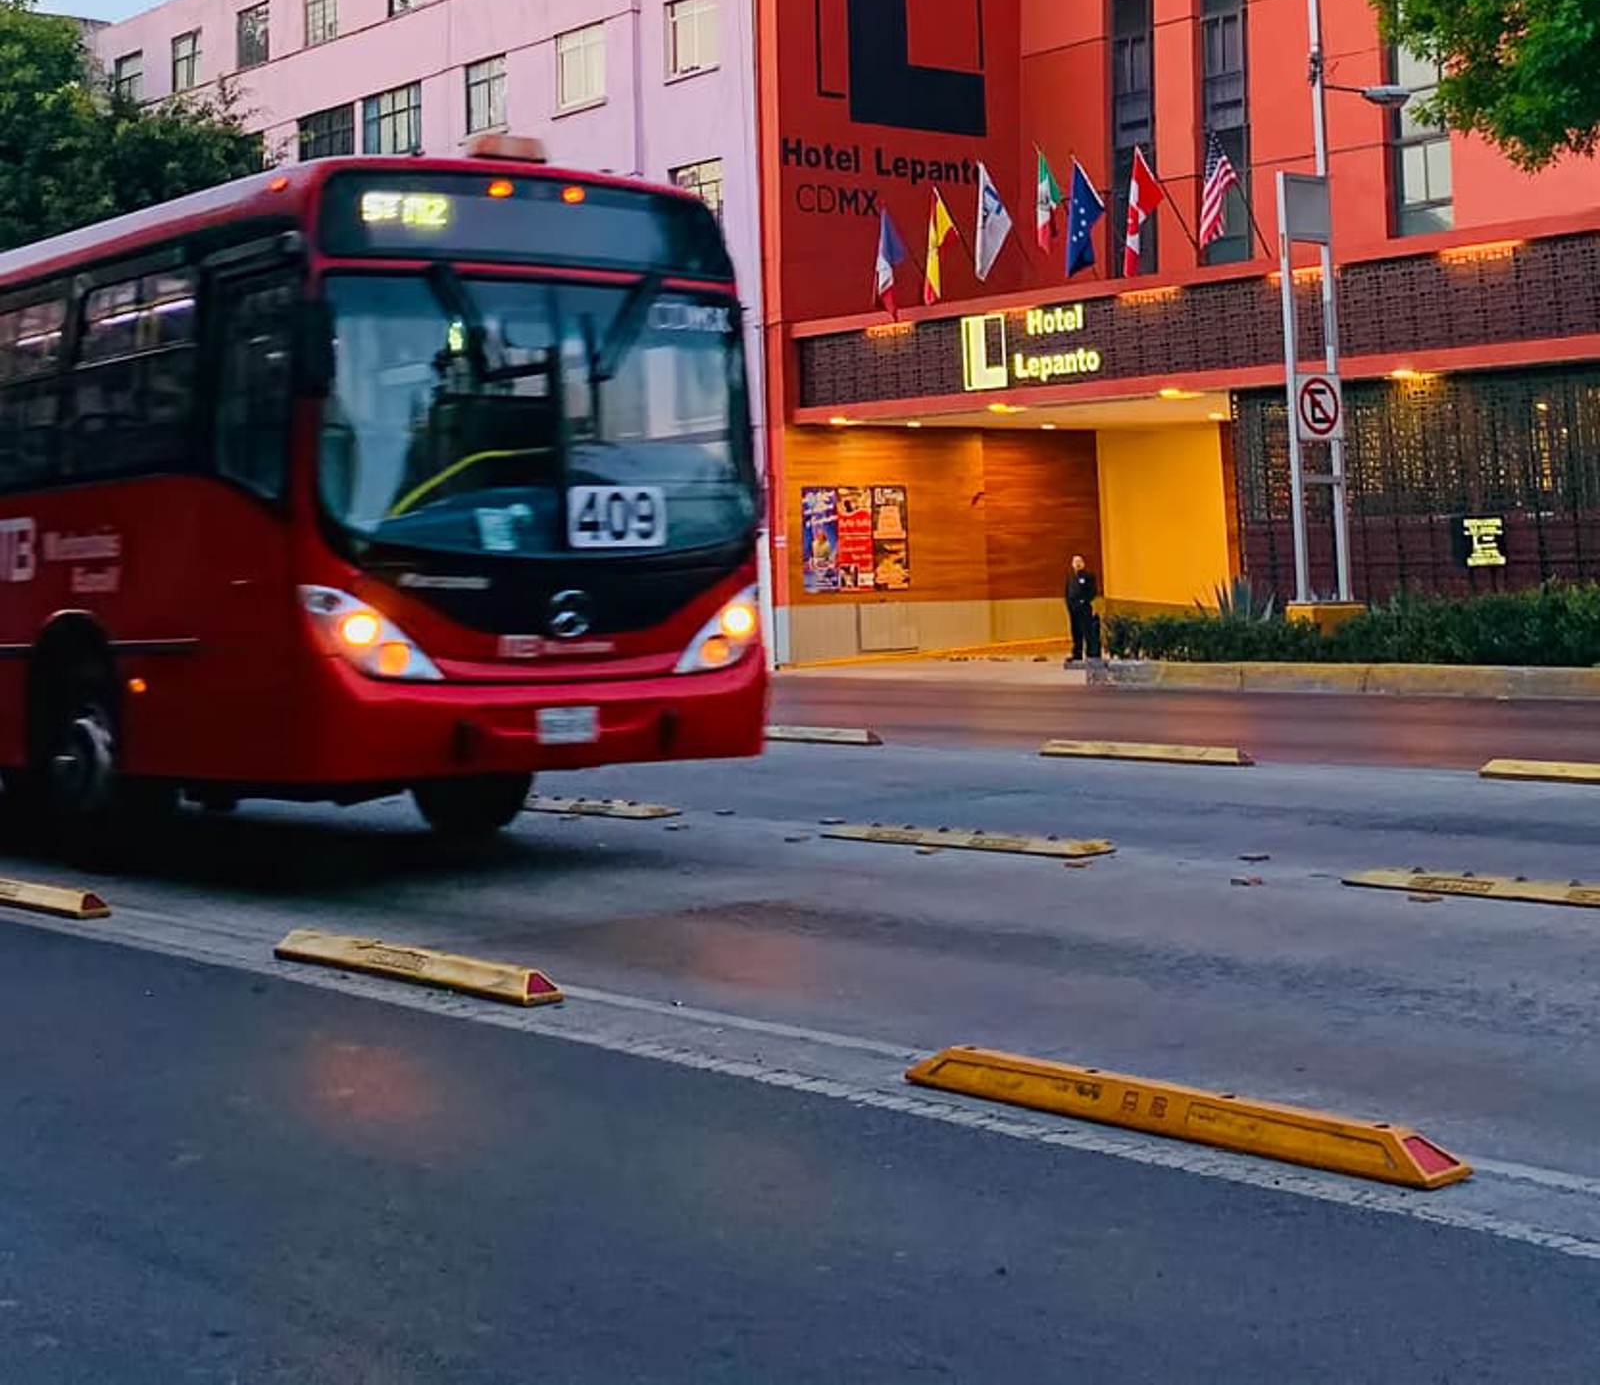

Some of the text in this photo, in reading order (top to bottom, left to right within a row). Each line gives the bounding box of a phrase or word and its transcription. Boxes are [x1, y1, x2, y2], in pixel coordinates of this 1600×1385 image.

[782, 137, 981, 185] Hotel Lepant
[796, 183, 880, 216] CDMX
[1026, 303, 1083, 335] Hotel
[1014, 347, 1100, 382] Lepanto
[577, 491, 656, 541] 409
